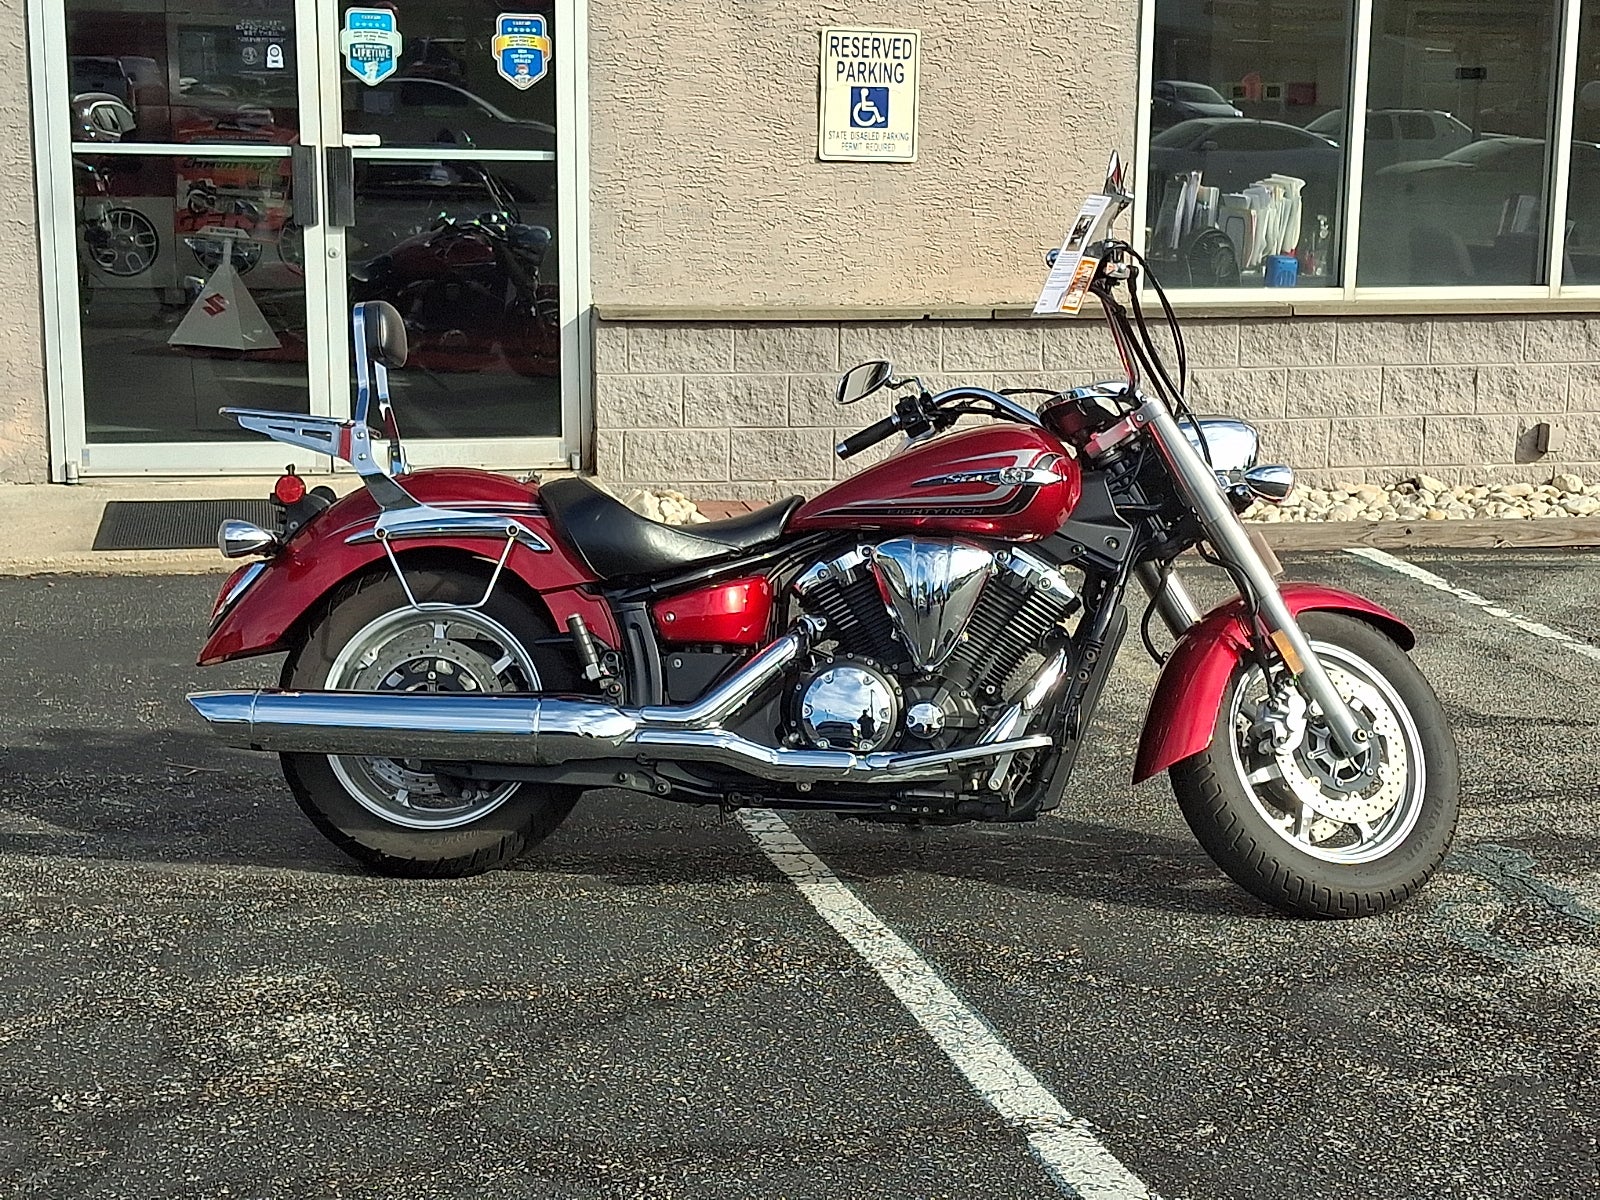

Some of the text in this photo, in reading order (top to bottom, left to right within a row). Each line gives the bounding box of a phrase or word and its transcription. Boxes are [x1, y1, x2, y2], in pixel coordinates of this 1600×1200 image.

[352, 48, 391, 59] LIFETIME
[830, 36, 912, 60] RESERVED
[836, 61, 905, 84] PARKING
[828, 130, 909, 141] STATE DISABLED PARKING
[841, 142, 896, 152] PERMIT REQUIRED
